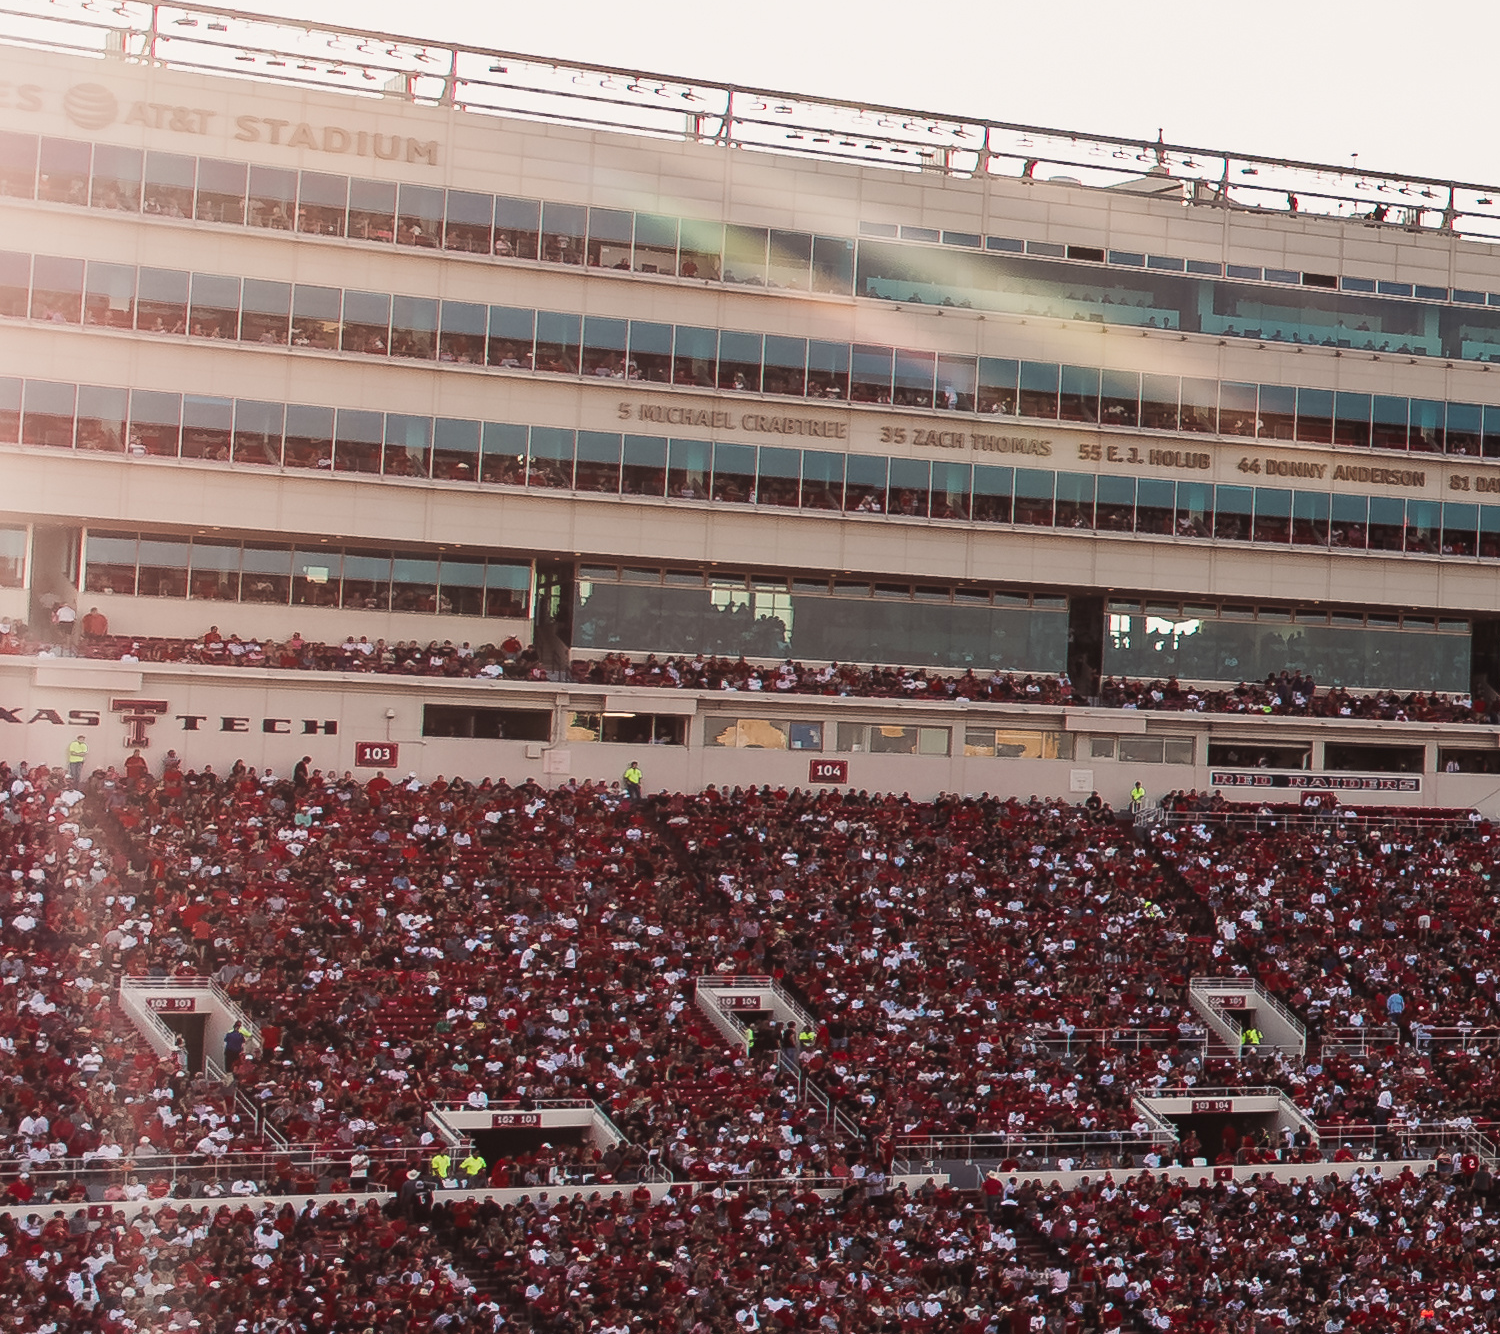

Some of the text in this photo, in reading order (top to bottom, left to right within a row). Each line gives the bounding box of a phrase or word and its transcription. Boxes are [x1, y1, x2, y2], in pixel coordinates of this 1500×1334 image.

[124, 102, 440, 166] AT&T STADIUM
[617, 402, 848, 439] 5 MICHAEL CRABTREE
[880, 426, 1052, 457] 35 ZACH THOMAS
[1078, 444, 1103, 461] 55
[1149, 449, 1211, 470] HOLUB
[1237, 457, 1426, 487] 44 DONNY ANDERSON
[1449, 474, 1471, 492] 81
[175, 714, 339, 736] TECH
[363, 747, 391, 761] 103
[816, 763, 843, 778] 104
[1213, 774, 1417, 791] RED RAIDERS
